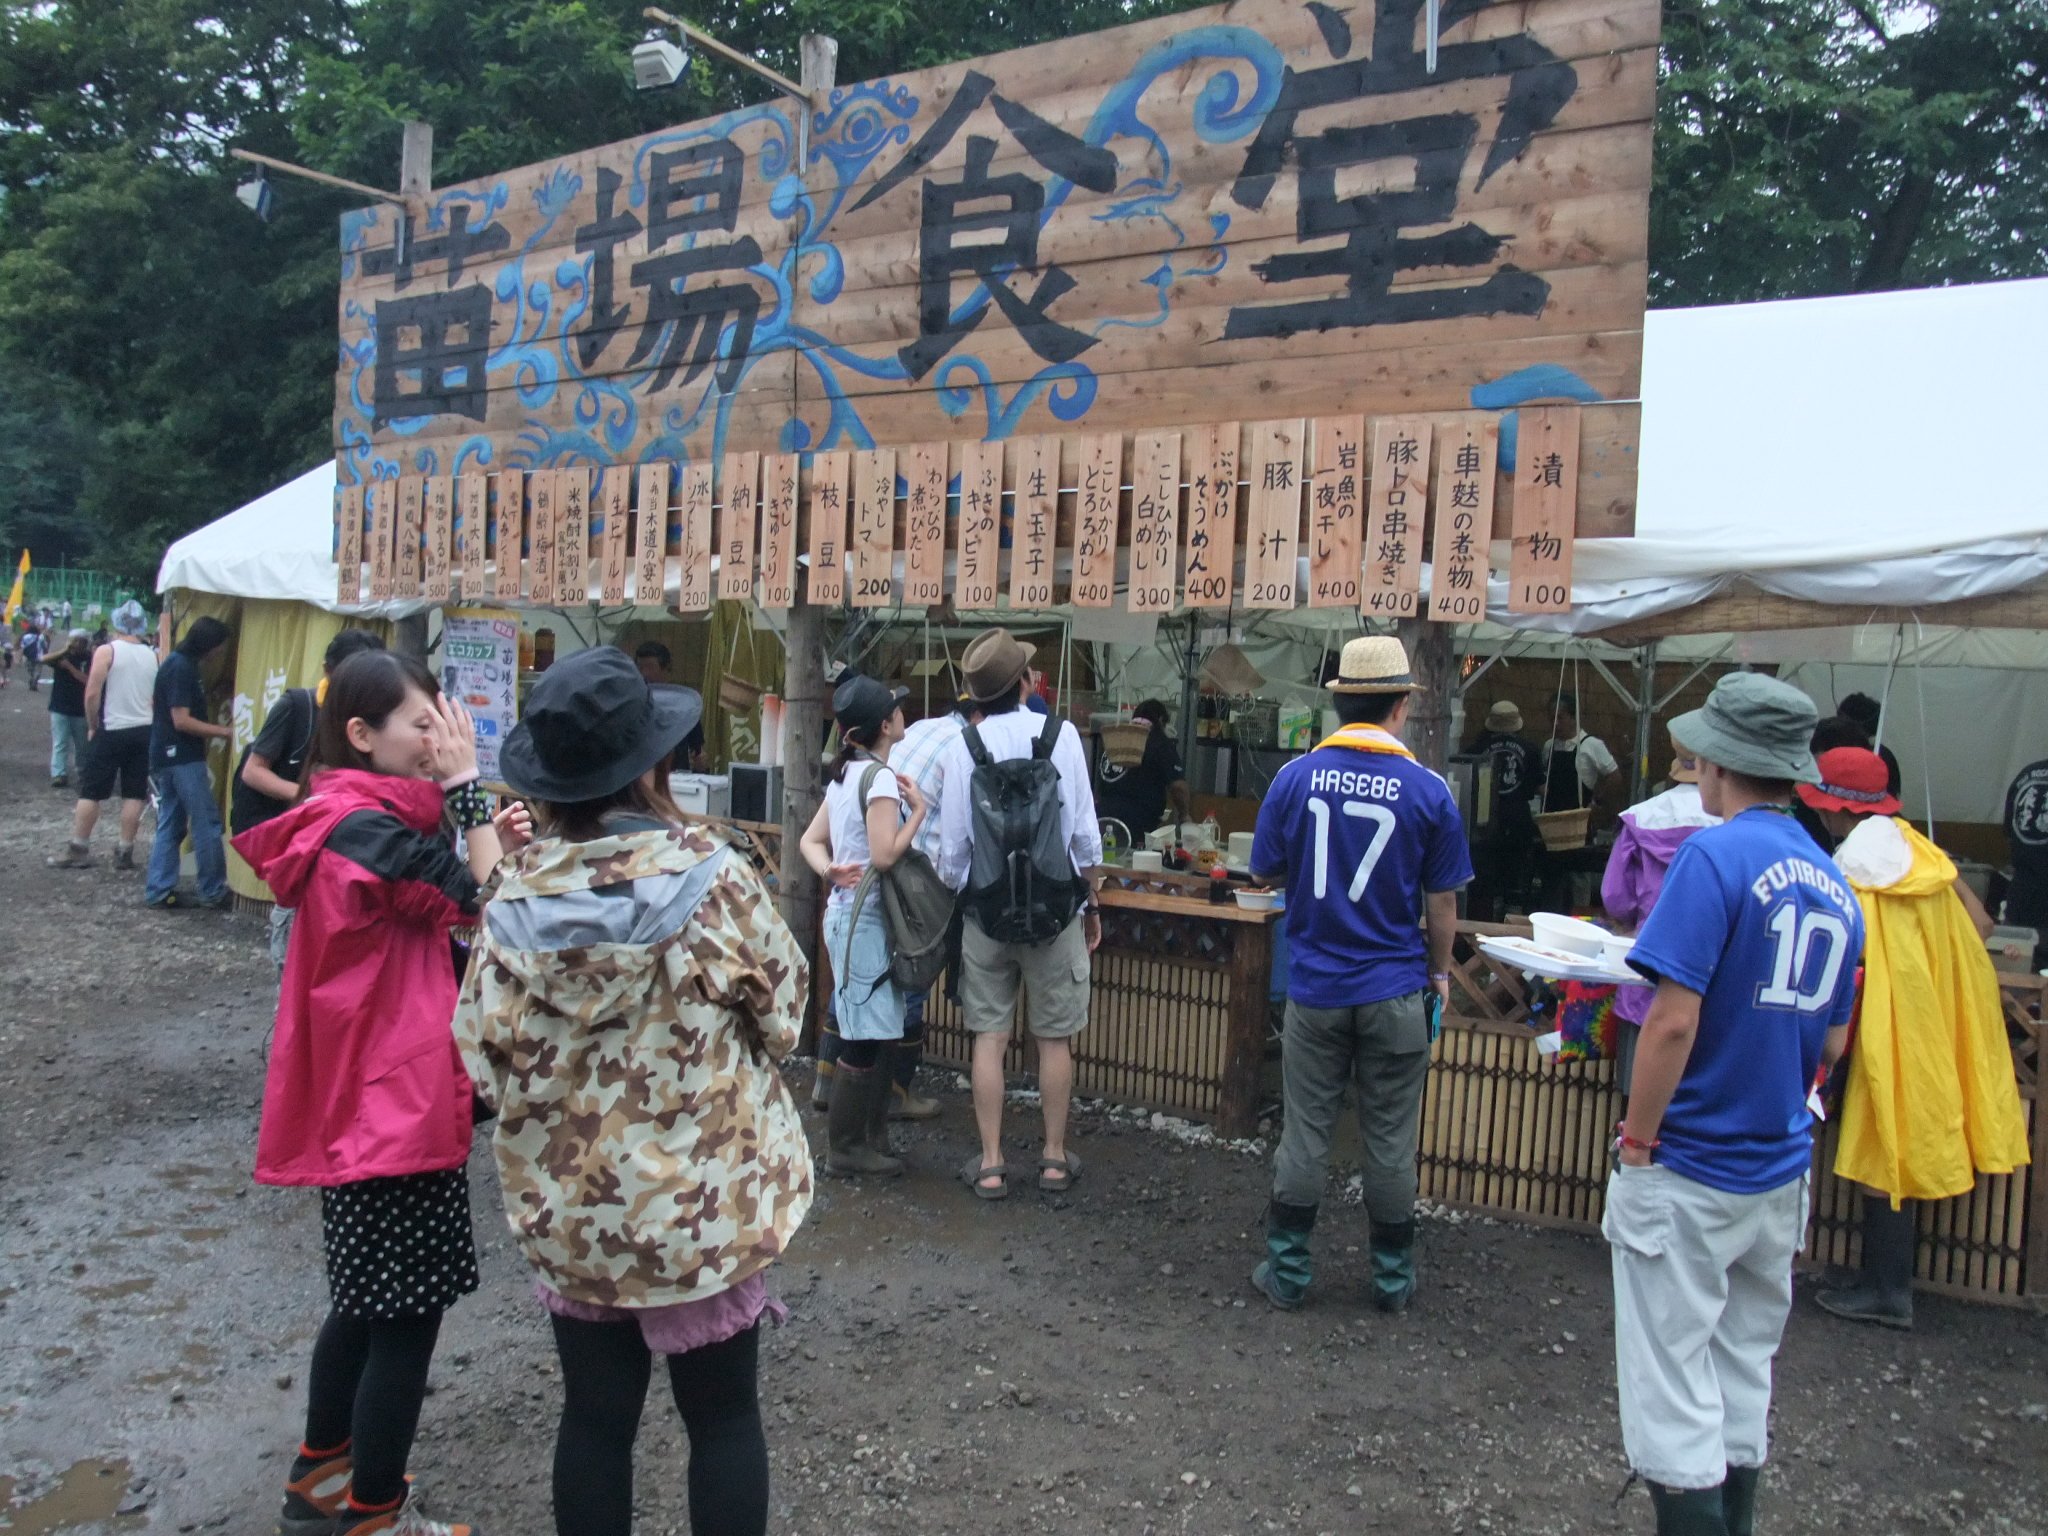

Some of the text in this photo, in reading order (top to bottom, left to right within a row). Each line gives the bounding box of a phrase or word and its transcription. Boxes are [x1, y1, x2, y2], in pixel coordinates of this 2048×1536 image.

[360, 0, 1578, 433] 苗場食堂
[781, 478, 794, 527] 冷やし
[876, 478, 890, 528] 冷やし
[927, 468, 942, 540] わらびの
[981, 469, 996, 531] ふきの
[1098, 461, 1114, 555] こしひかり
[1214, 451, 1234, 518] ぶっかけ
[1260, 461, 1294, 561] 豚汁
[1337, 443, 1357, 519] 岩魚の
[1527, 454, 1564, 562] 漬物
[567, 487, 582, 580] 米焼酎水割り
[609, 496, 623, 578] 生ビール
[686, 485, 696, 587] ソフトドリンク
[728, 483, 750, 565] 納豆
[769, 499, 780, 579] きゅうり
[818, 483, 840, 568] 枝豆
[859, 502, 872, 568] トマト
[911, 487, 927, 570] 煮びたし
[964, 490, 981, 577] キンピラ
[1025, 468, 1047, 575] 生玉子
[1079, 465, 1099, 576] とろろめし
[1136, 494, 1155, 570] 白めし
[1156, 464, 1171, 567] こしひかり
[1187, 475, 1209, 574] そうめん
[1316, 469, 1336, 558] 一夜干し
[1377, 439, 1419, 586] 豚トロ串焼き
[1448, 443, 1481, 590] 車麩の煮物
[400, 582, 416, 595] 500
[429, 584, 446, 597] 500
[466, 581, 481, 594] 500
[533, 585, 550, 599] 600
[560, 588, 584, 602] 500
[604, 587, 621, 599] 600
[636, 586, 660, 600] 1500
[685, 592, 706, 606] 200
[726, 579, 749, 593] 100
[767, 587, 790, 601] 100
[816, 584, 839, 599] 100
[857, 578, 890, 596] 200
[912, 583, 939, 598] 100
[965, 586, 992, 602] 100
[1020, 585, 1048, 601] 100
[1079, 584, 1108, 600] 400
[1137, 588, 1170, 606] 300
[1189, 577, 1226, 600] 400
[1253, 583, 1291, 601] 200
[1318, 581, 1356, 599] 400
[1370, 593, 1412, 612] 400
[1438, 598, 1480, 616] 400
[1524, 585, 1566, 605] 100
[1311, 769, 1402, 801] HASEBE
[1308, 797, 1396, 903] 17
[1756, 900, 1849, 1012] 10
